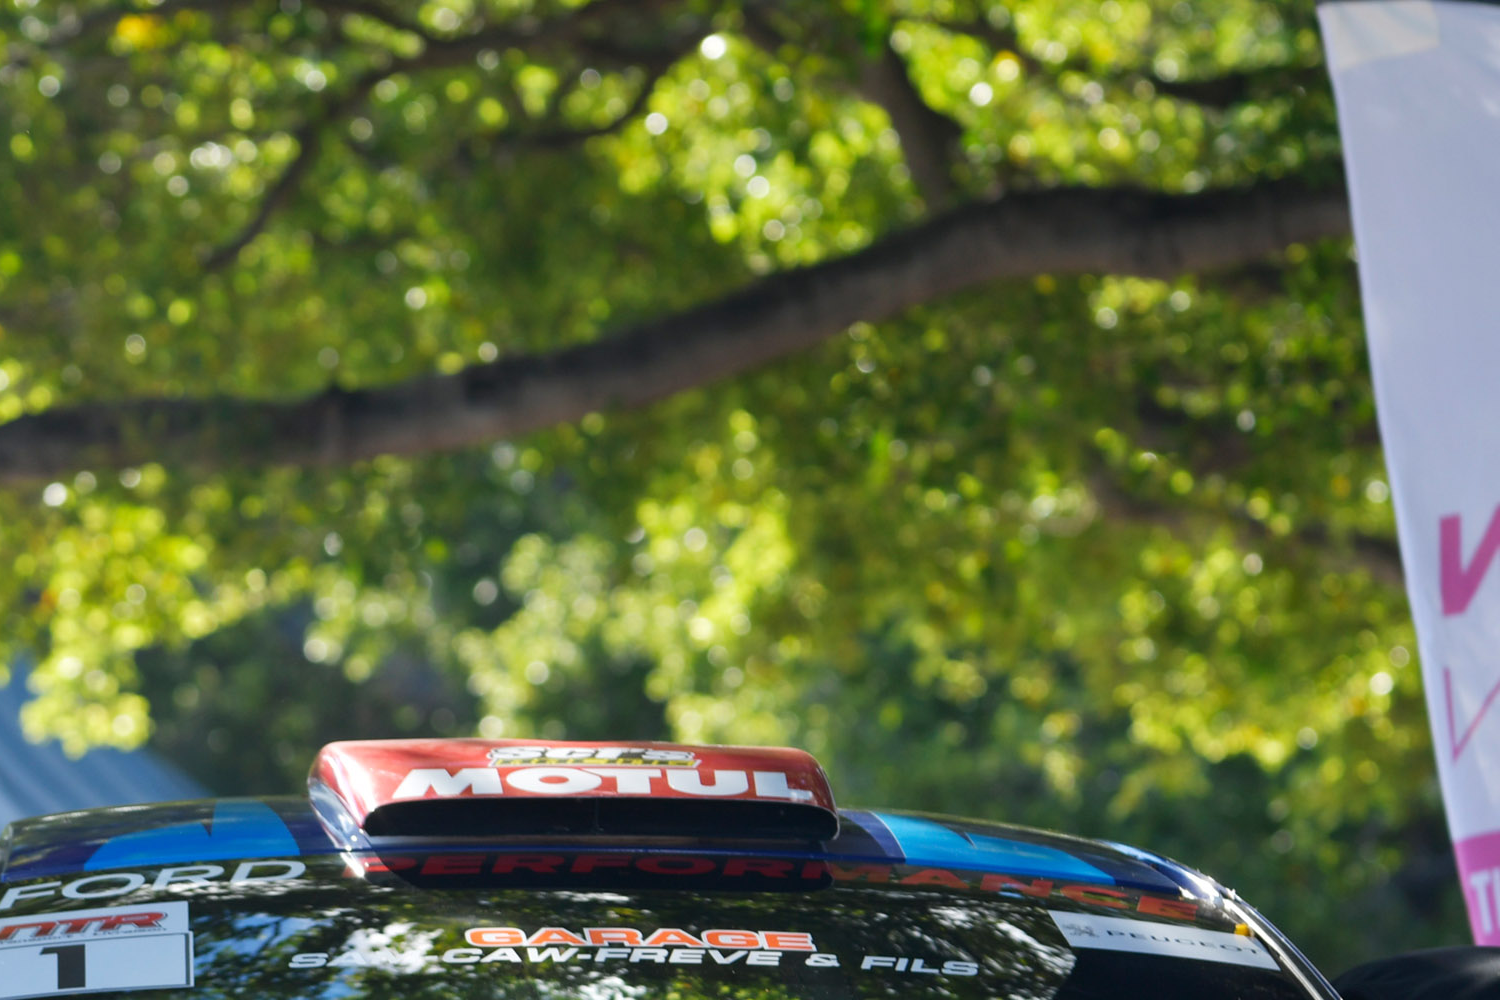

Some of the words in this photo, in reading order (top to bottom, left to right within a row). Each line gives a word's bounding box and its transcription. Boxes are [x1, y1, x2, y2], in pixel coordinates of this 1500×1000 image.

[392, 768, 813, 799] MOTUL
[343, 853, 1198, 921] PERFORMANCE
[465, 926, 818, 951] GARAGE
[1106, 928, 1260, 955] PEUGEOT
[39, 943, 86, 990] 1
[805, 953, 840, 968] &
[860, 955, 979, 976] FILS
